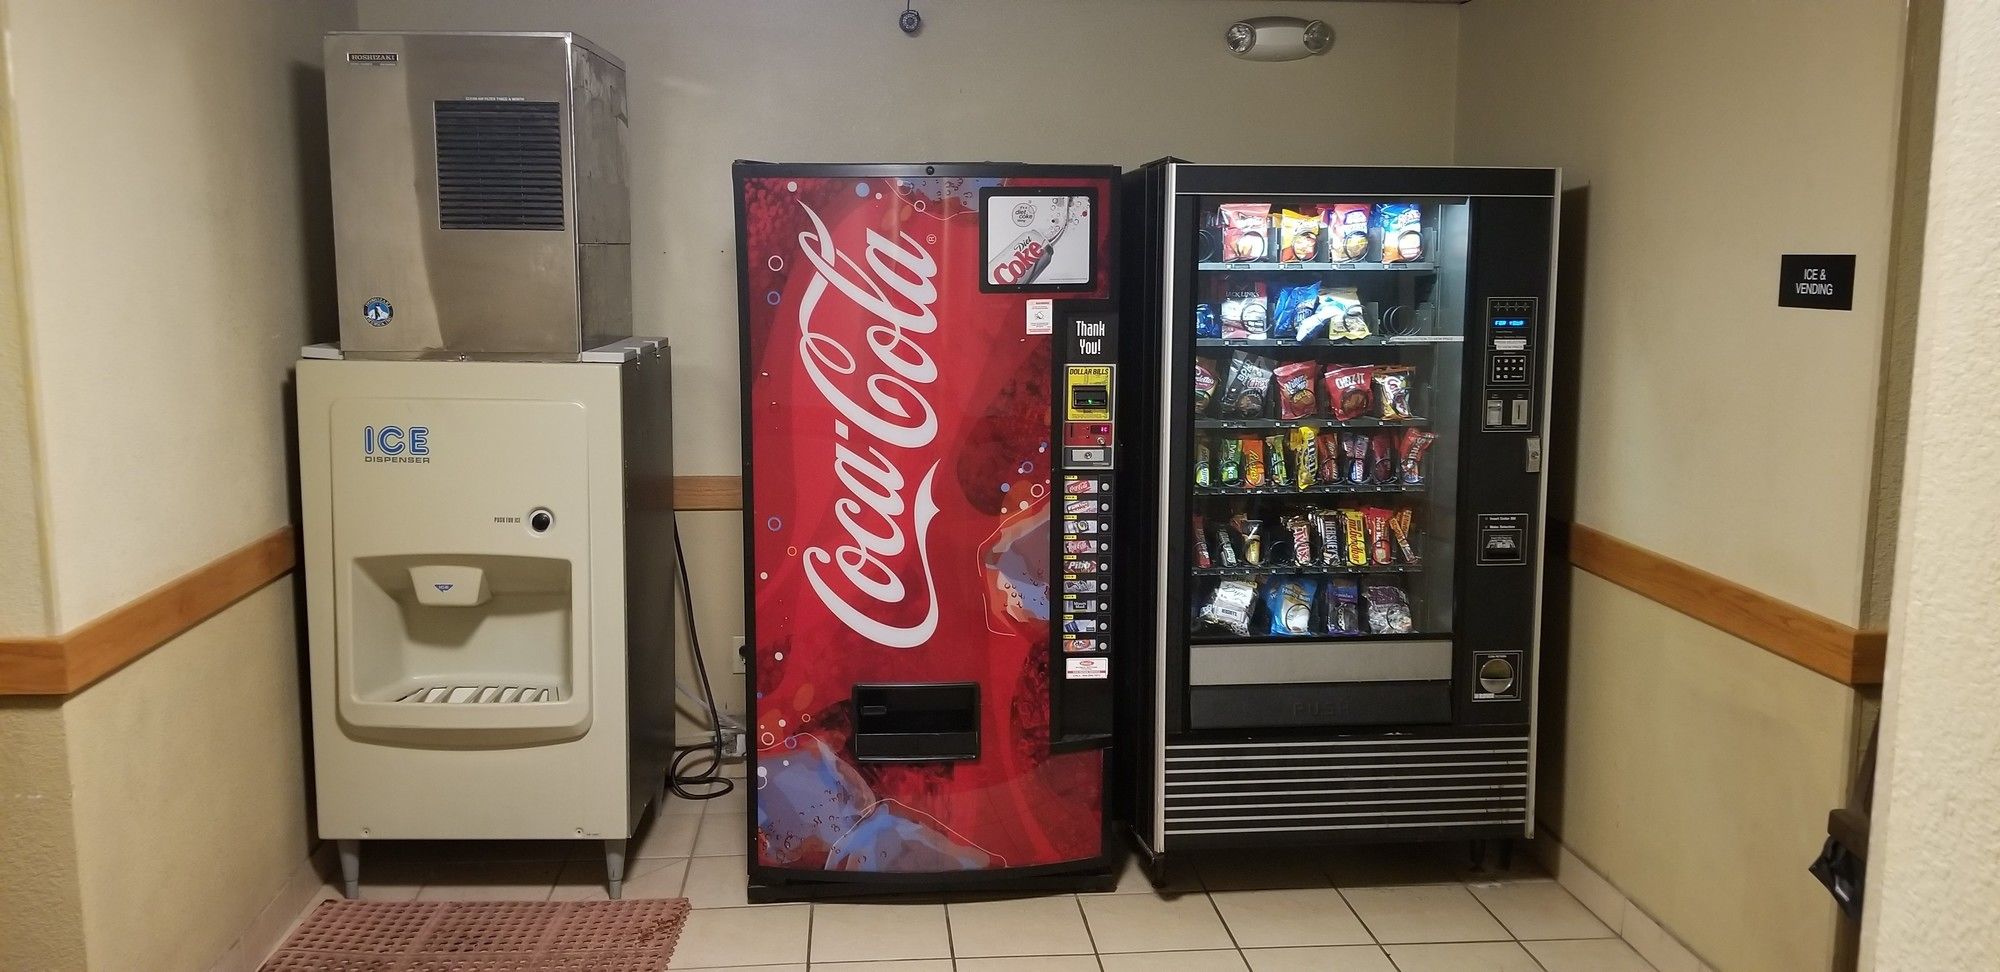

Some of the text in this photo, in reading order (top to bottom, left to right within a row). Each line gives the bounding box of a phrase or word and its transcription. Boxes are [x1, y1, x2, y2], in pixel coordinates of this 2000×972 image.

[1015, 236, 1032, 252] Diet
[993, 241, 1044, 285] Coke
[1804, 269, 1826, 280] ICE &
[1795, 283, 1833, 295] VENDING
[1076, 320, 1105, 336] Thank
[1080, 339, 1101, 354] You!
[1093, 368, 1109, 376] BILLS
[1335, 373, 1365, 389] CHEEZ-IT
[797, 198, 941, 649] Coca-Cola
[365, 426, 429, 455] ICE
[1325, 520, 1339, 561] HERSHEY'S
